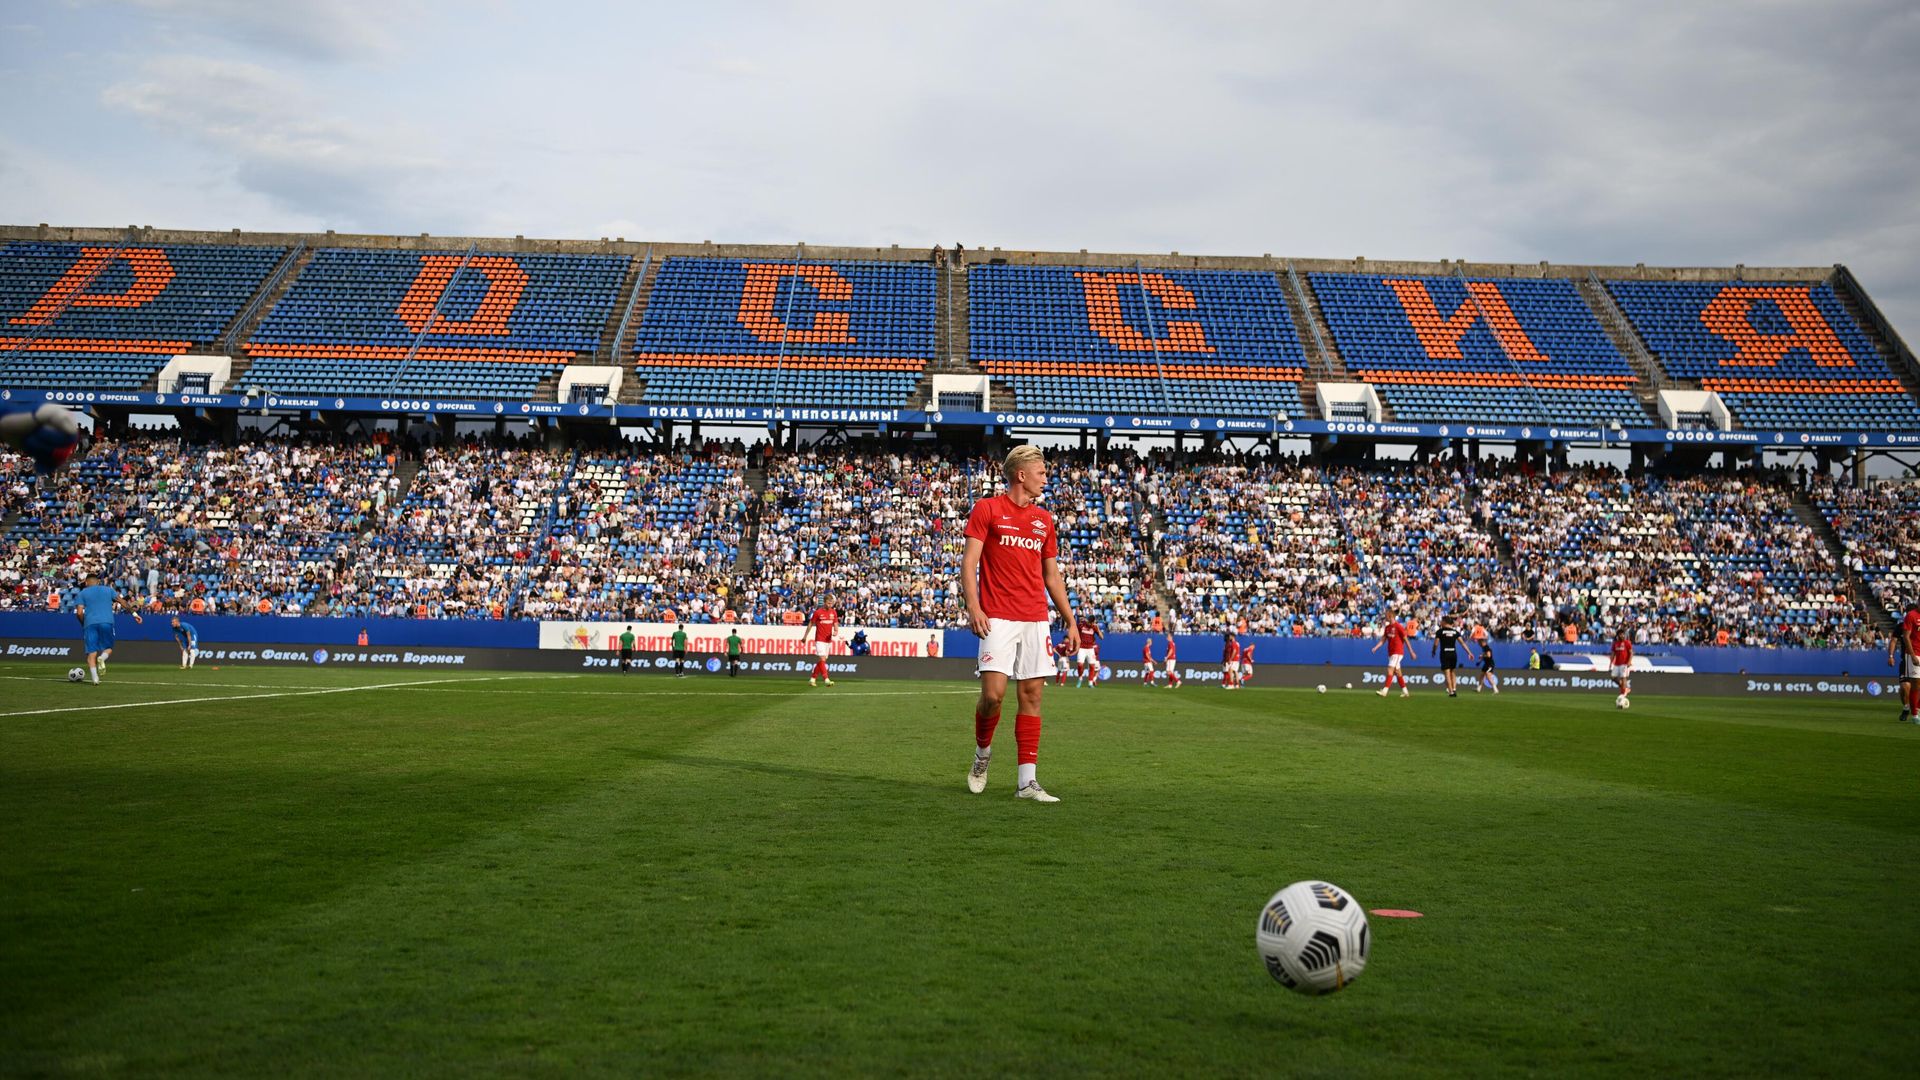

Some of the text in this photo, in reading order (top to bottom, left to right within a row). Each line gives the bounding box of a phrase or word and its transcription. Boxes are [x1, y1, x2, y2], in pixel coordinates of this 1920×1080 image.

[191, 395, 222, 404] FAKELTV
[435, 402, 477, 411] @PFCFAKEL
[531, 404, 562, 413] FAKELTV
[648, 406, 690, 418] ПОКА
[696, 408, 746, 419] ЕДИНЫ
[791, 409, 899, 422] НЕПОБЕДИМЫ!
[1049, 415, 1090, 425] @PFCFAKEL
[1142, 418, 1173, 427] FAKELTV
[1476, 428, 1507, 436] FAKELTV
[1811, 435, 1842, 443] FAKELTV
[7, 644, 71, 657] Воронеж
[216, 650, 226, 659] и
[229, 650, 257, 660] есть
[261, 648, 309, 662] Факел,
[333, 652, 356, 662] это
[358, 652, 369, 662] и
[370, 653, 399, 664] есть
[402, 652, 466, 665] Воронеж
[583, 656, 608, 667] Это
[610, 658, 620, 667] и
[654, 657, 702, 670] Фаел,
[751, 661, 761, 671] и
[762, 661, 791, 672] есть
[1115, 669, 1139, 678] это
[1362, 671, 1386, 683] Это
[1432, 673, 1480, 686] Фкел,
[1503, 677, 1525, 686] это
[1527, 677, 1536, 686] и
[1539, 678, 1567, 688] есть
[1747, 680, 1901, 694] Это и есть Факел, эт
